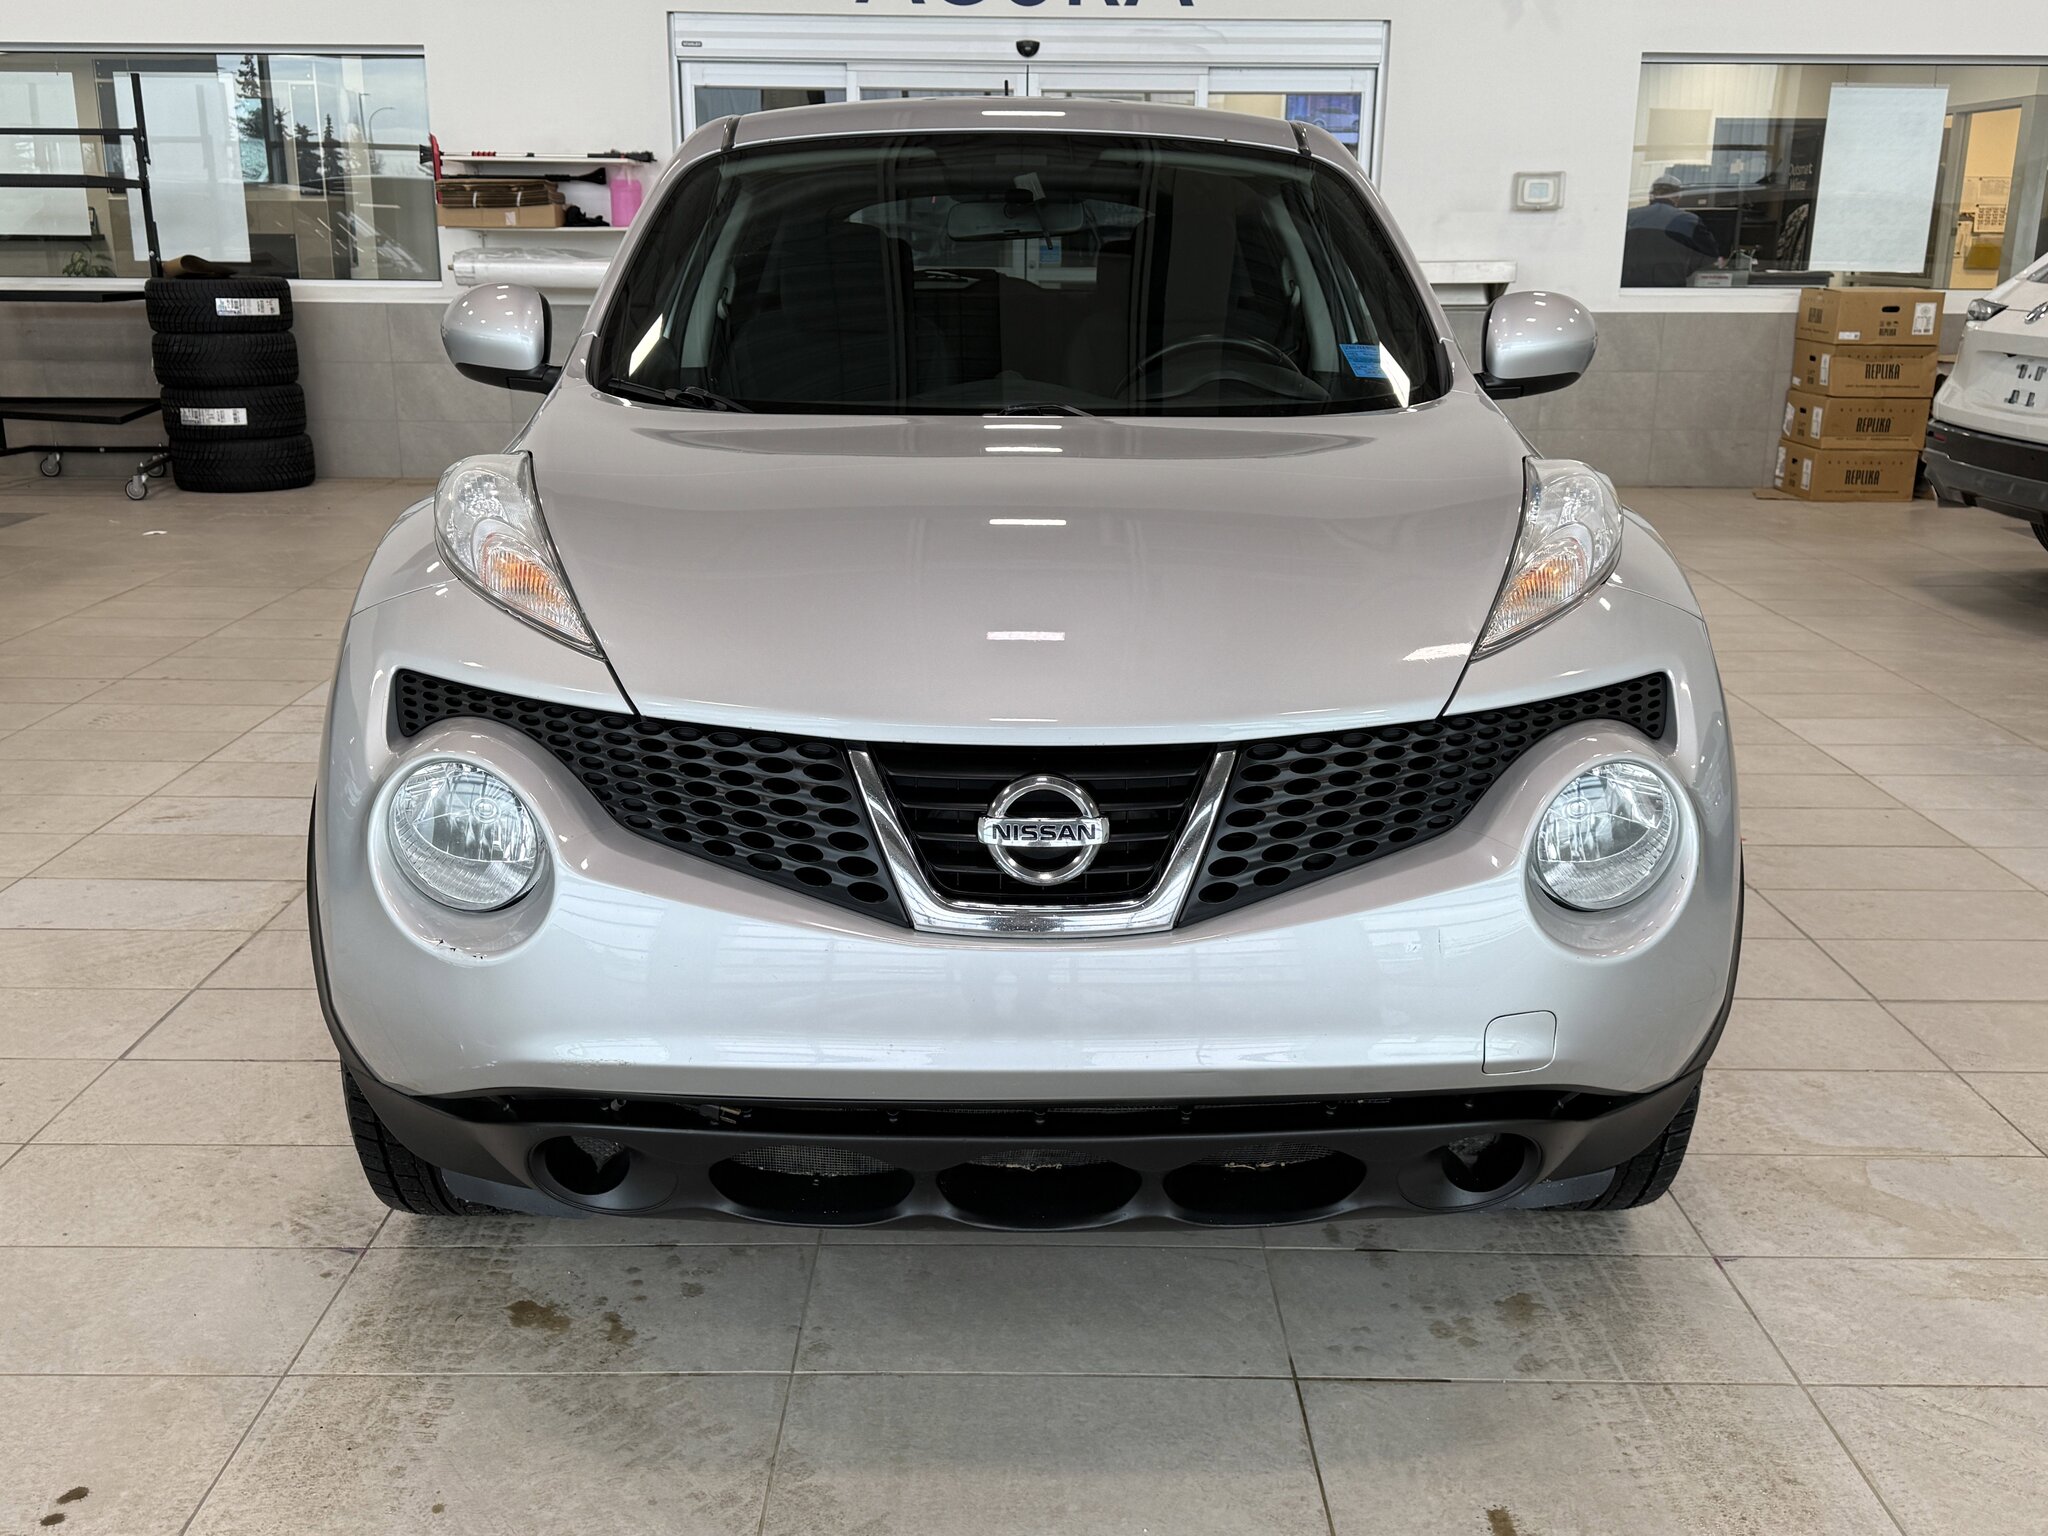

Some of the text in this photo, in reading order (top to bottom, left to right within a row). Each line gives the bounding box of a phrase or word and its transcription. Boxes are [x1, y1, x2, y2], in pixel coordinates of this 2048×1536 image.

[1865, 364, 1900, 379] REPLIKA
[1856, 417, 1891, 432] REPLIKA
[1845, 470, 1880, 485] REPLIKA
[992, 824, 1096, 841] NISSAN
